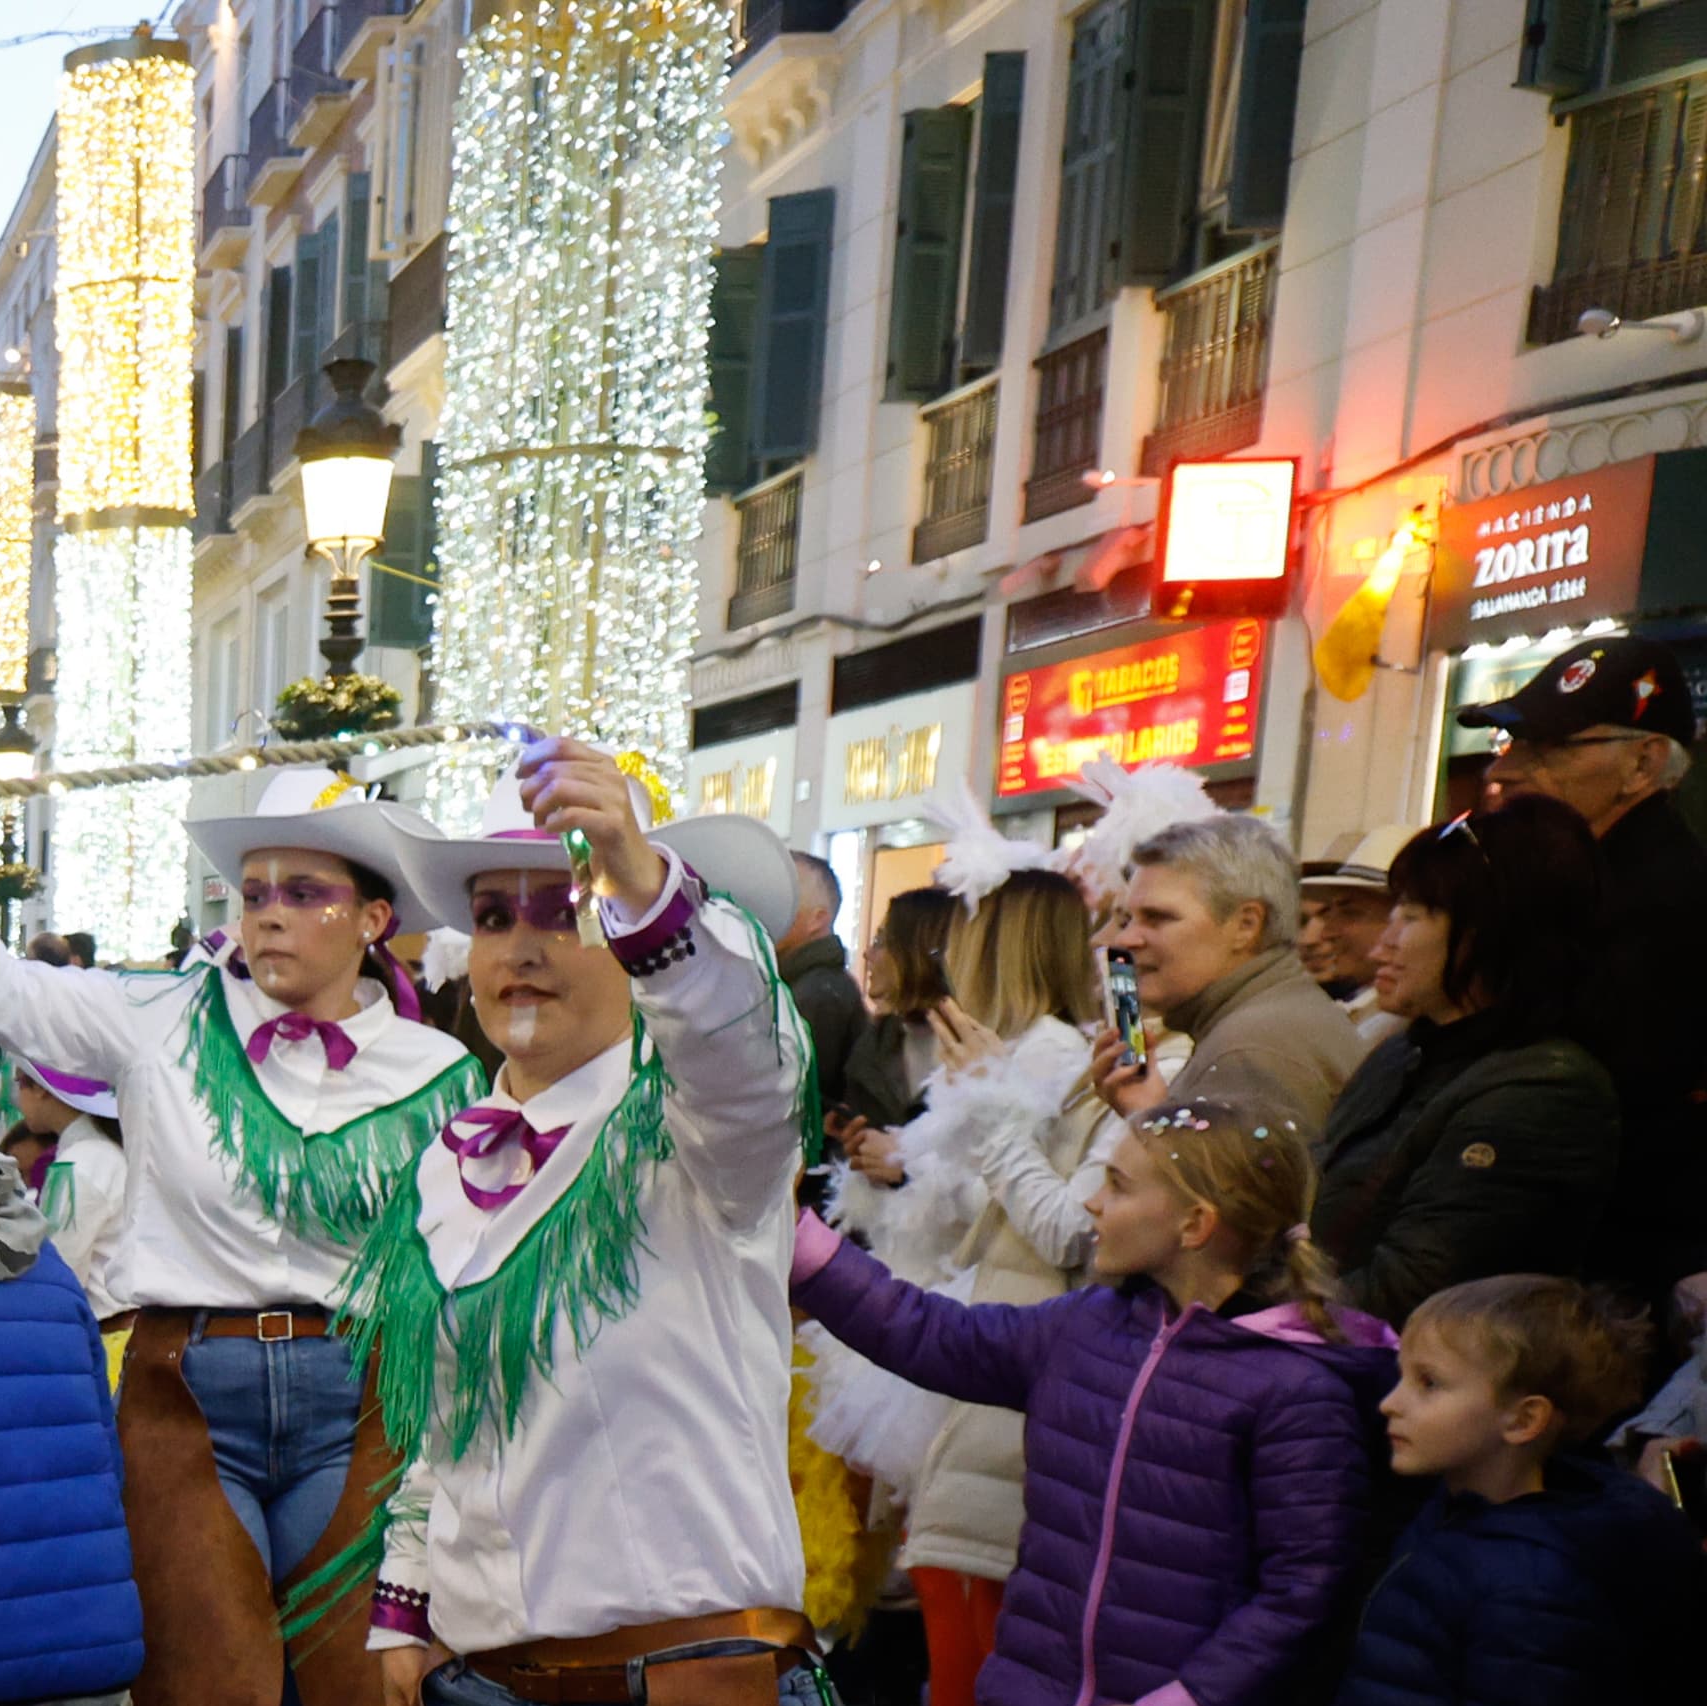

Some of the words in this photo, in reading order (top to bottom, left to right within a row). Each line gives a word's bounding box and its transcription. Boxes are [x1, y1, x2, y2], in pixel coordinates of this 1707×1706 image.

[1477, 493, 1592, 538] HACIENDA
[1470, 585, 1548, 621] SALAMANCA
[1094, 652, 1180, 697] TABACOS
[1124, 717, 1199, 764] LARIOS
